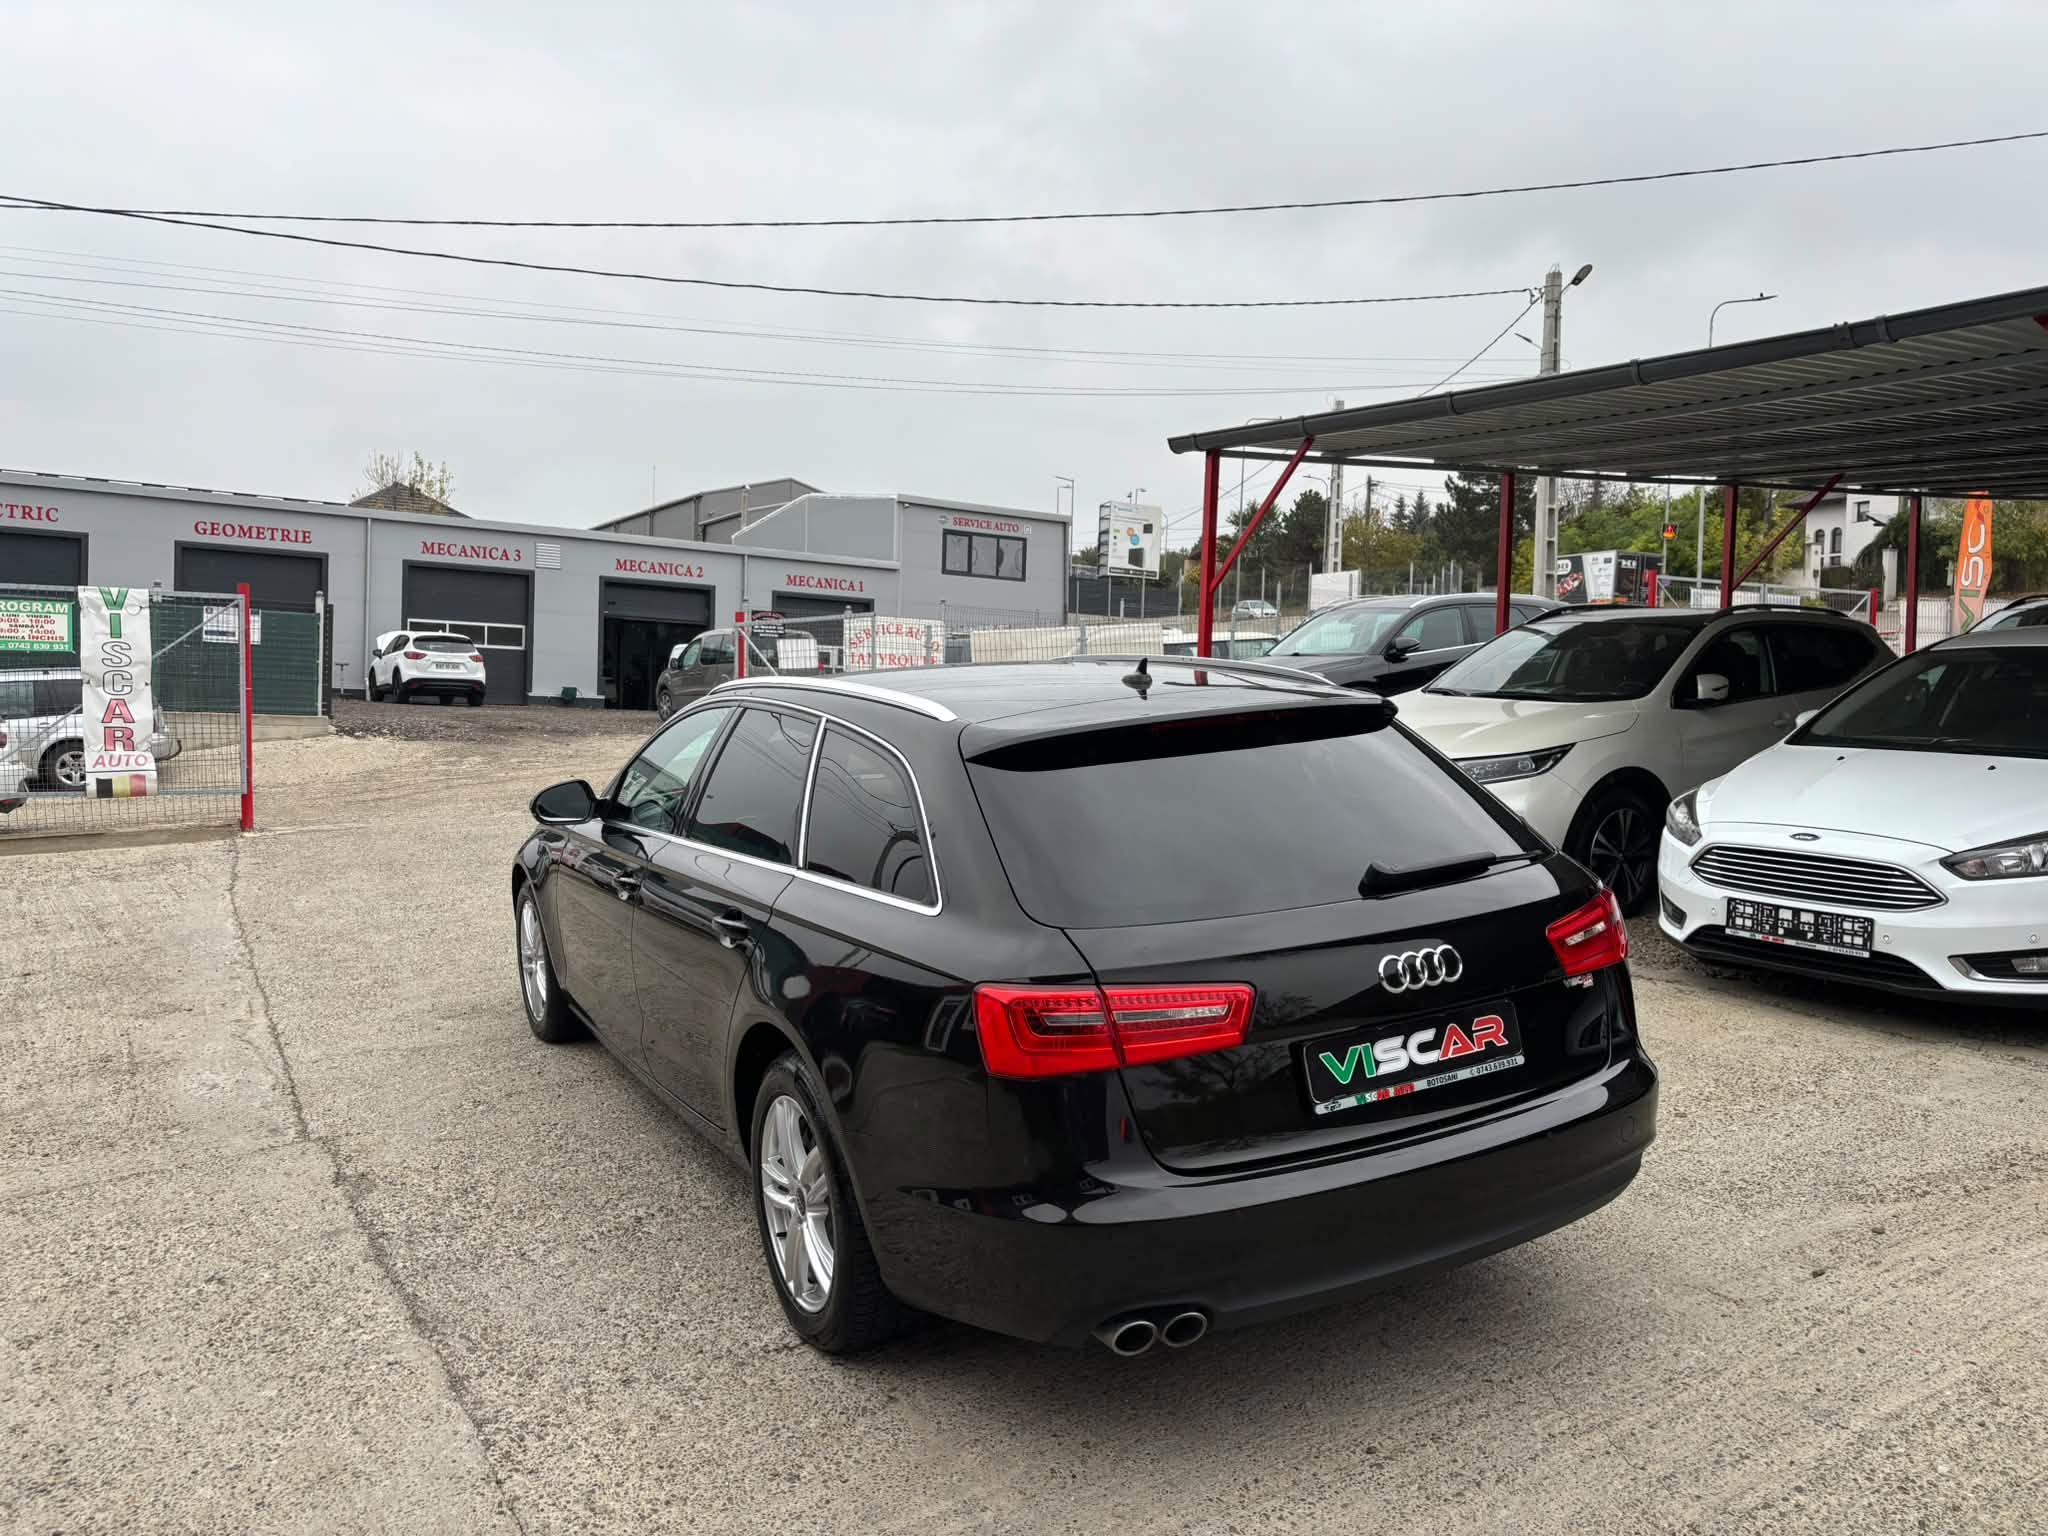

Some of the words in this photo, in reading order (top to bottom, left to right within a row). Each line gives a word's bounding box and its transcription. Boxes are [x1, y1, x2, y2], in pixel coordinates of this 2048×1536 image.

[0, 503, 59, 522] TRIC
[194, 520, 313, 545] GEOMETRIE
[953, 517, 992, 530] SERVICE
[993, 521, 1020, 533] AUTO
[421, 541, 510, 561] MECANICA
[513, 550, 522, 562] 3
[615, 558, 694, 577] MECANICA
[696, 566, 705, 578] 2
[786, 574, 856, 592] MECANICA
[859, 580, 864, 592] 1
[99, 586, 136, 751] VISCAR
[93, 754, 148, 769] AUTO
[1319, 1014, 1509, 1085] VISCAR
[1426, 1072, 1459, 1088] BOTOSANI
